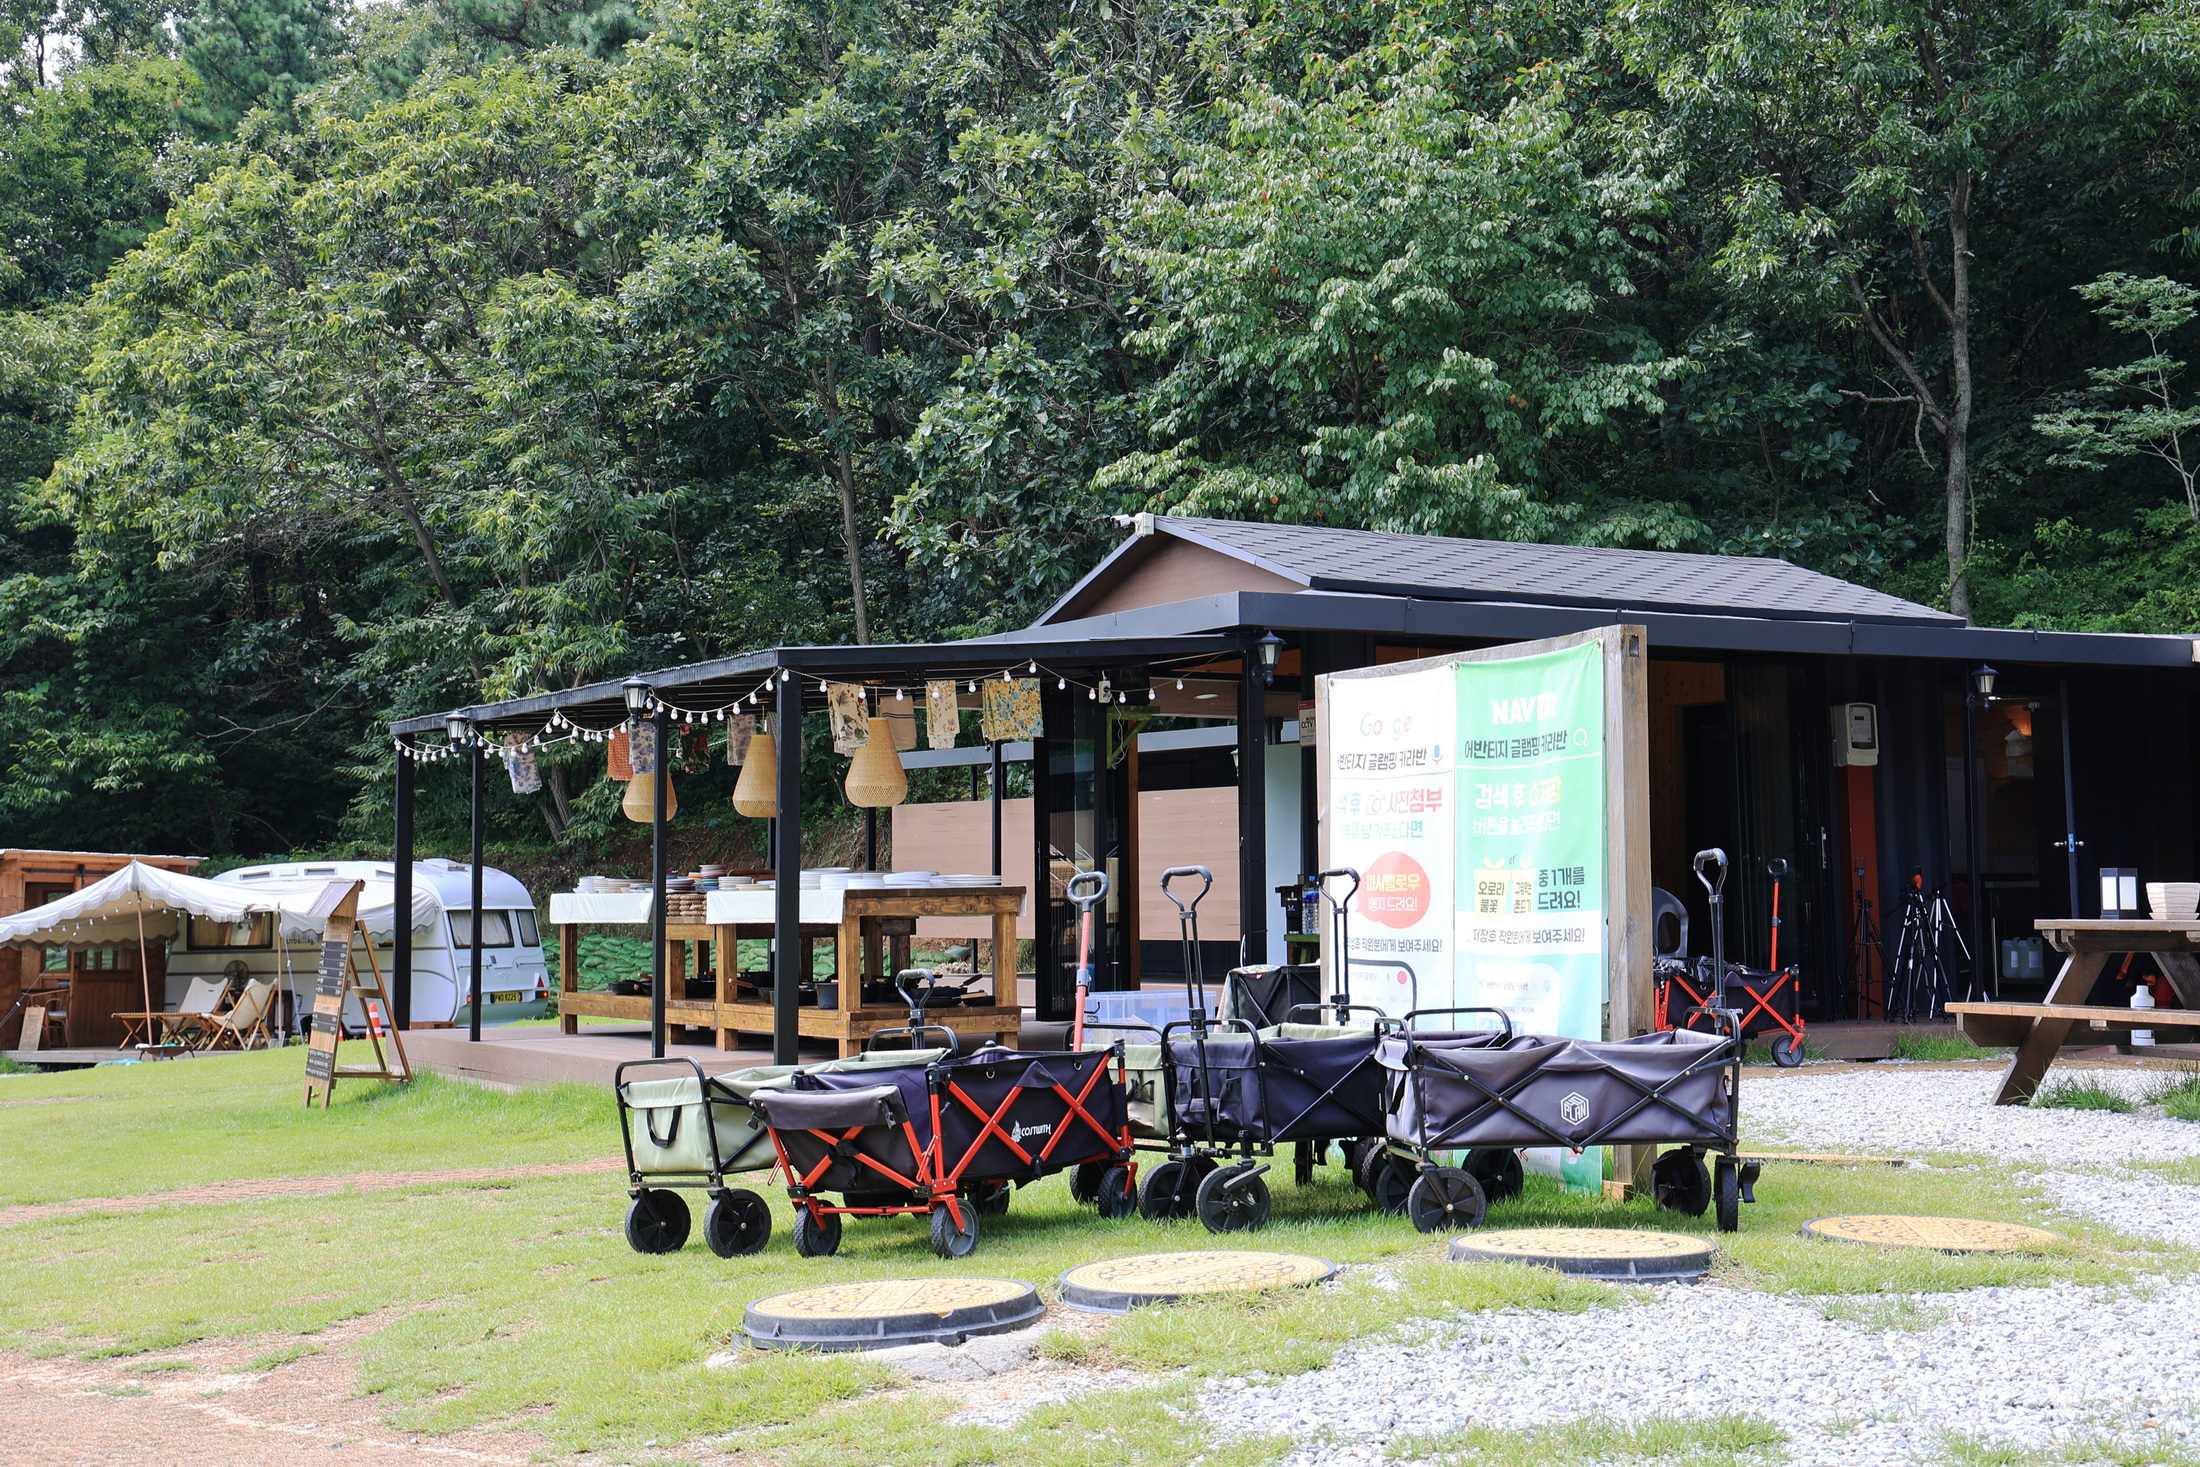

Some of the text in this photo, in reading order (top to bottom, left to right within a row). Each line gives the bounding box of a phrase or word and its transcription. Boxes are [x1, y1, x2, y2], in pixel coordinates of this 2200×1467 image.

[1492, 692, 1559, 725] NAVER
[1301, 720, 1314, 729] CCTV
[1464, 740, 1509, 759] 어반티지
[1511, 737, 1540, 758] 글램핑
[1337, 752, 1367, 770] 반티지
[1368, 751, 1397, 770] 글램핑
[1350, 791, 1362, 815] 후
[1387, 788, 1443, 814] 사진첨부
[1475, 783, 1509, 809] 검색
[1511, 781, 1525, 809] 후
[1366, 873, 1420, 892] 마시멜로우
[1538, 866, 1585, 887] 중 1개를
[1477, 881, 1505, 896] 오로라
[1386, 896, 1418, 911] 드려요!
[1537, 890, 1581, 910] 드려요!
[1532, 927, 1585, 943] 보여주세요!
[1398, 938, 1443, 952] 보여주세요!
